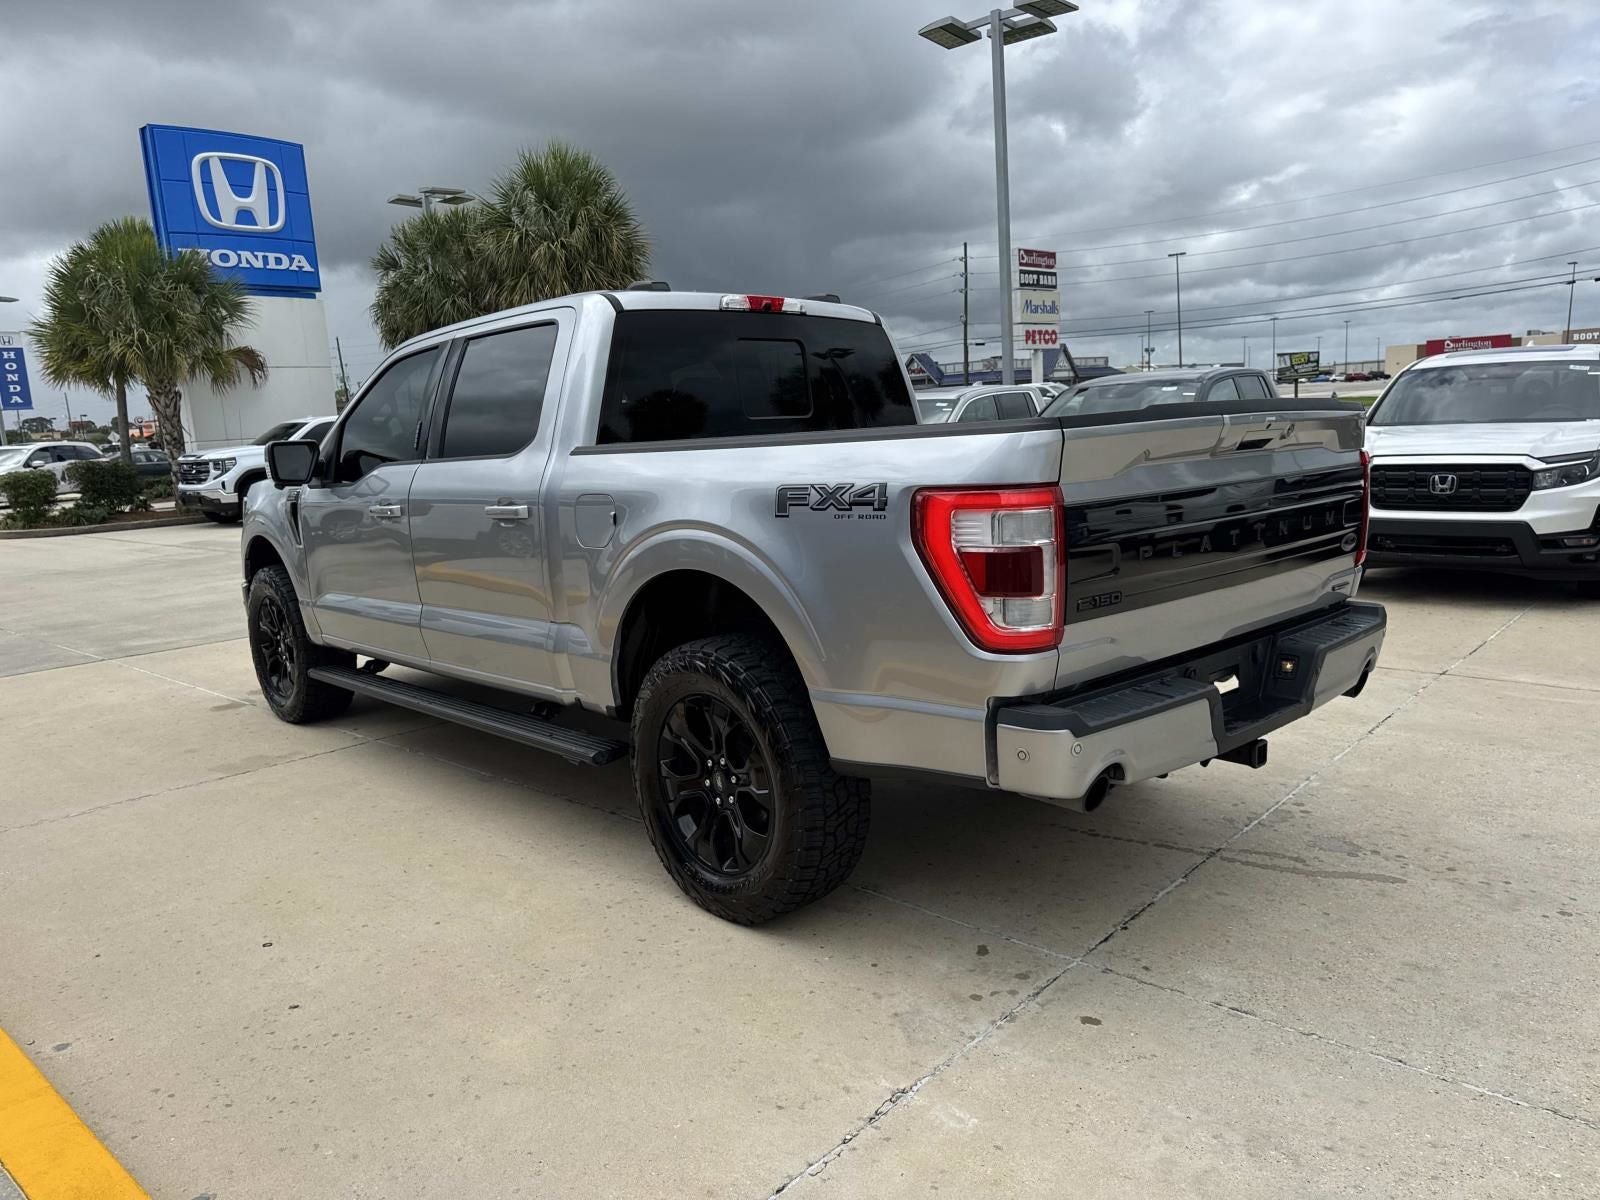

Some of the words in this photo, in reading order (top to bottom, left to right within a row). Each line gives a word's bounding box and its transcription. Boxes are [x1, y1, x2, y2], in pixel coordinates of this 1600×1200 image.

[1020, 250, 1056, 268] Burlington
[1020, 273, 1038, 284] BOOT
[1023, 299, 1059, 314] Marshalls
[1024, 329, 1058, 344] PETCO
[1573, 331, 1600, 341] BOOT
[1444, 340, 1492, 349] Burlington
[2, 351, 24, 403] HONDA
[775, 482, 888, 518] FX4
[1139, 510, 1336, 561] PLATINUM
